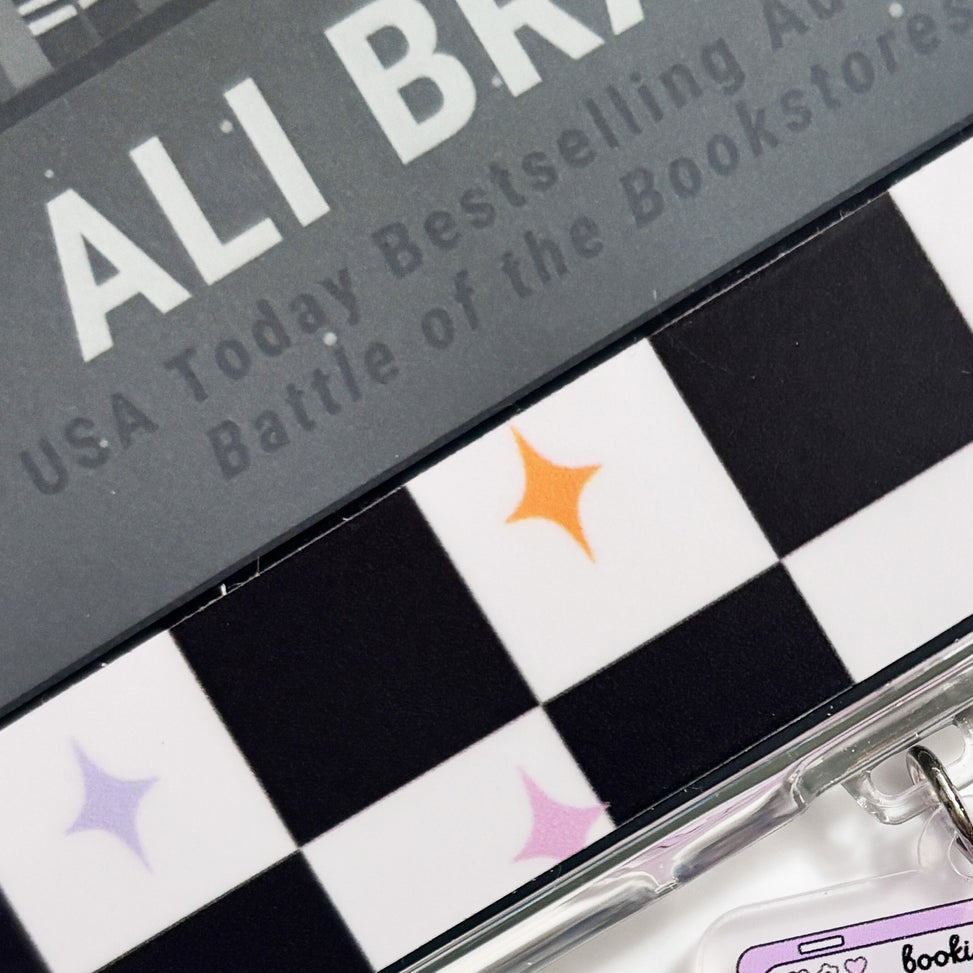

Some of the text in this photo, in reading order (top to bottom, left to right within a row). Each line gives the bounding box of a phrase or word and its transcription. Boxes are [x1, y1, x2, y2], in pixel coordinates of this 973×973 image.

[20, 392, 160, 495] USA
[163, 266, 362, 402] Today
[371, 37, 746, 278] Bestselling
[46, 0, 645, 362] ALI BR
[205, 341, 400, 481] Battle
[420, 269, 480, 351] of
[500, 213, 604, 299] the
